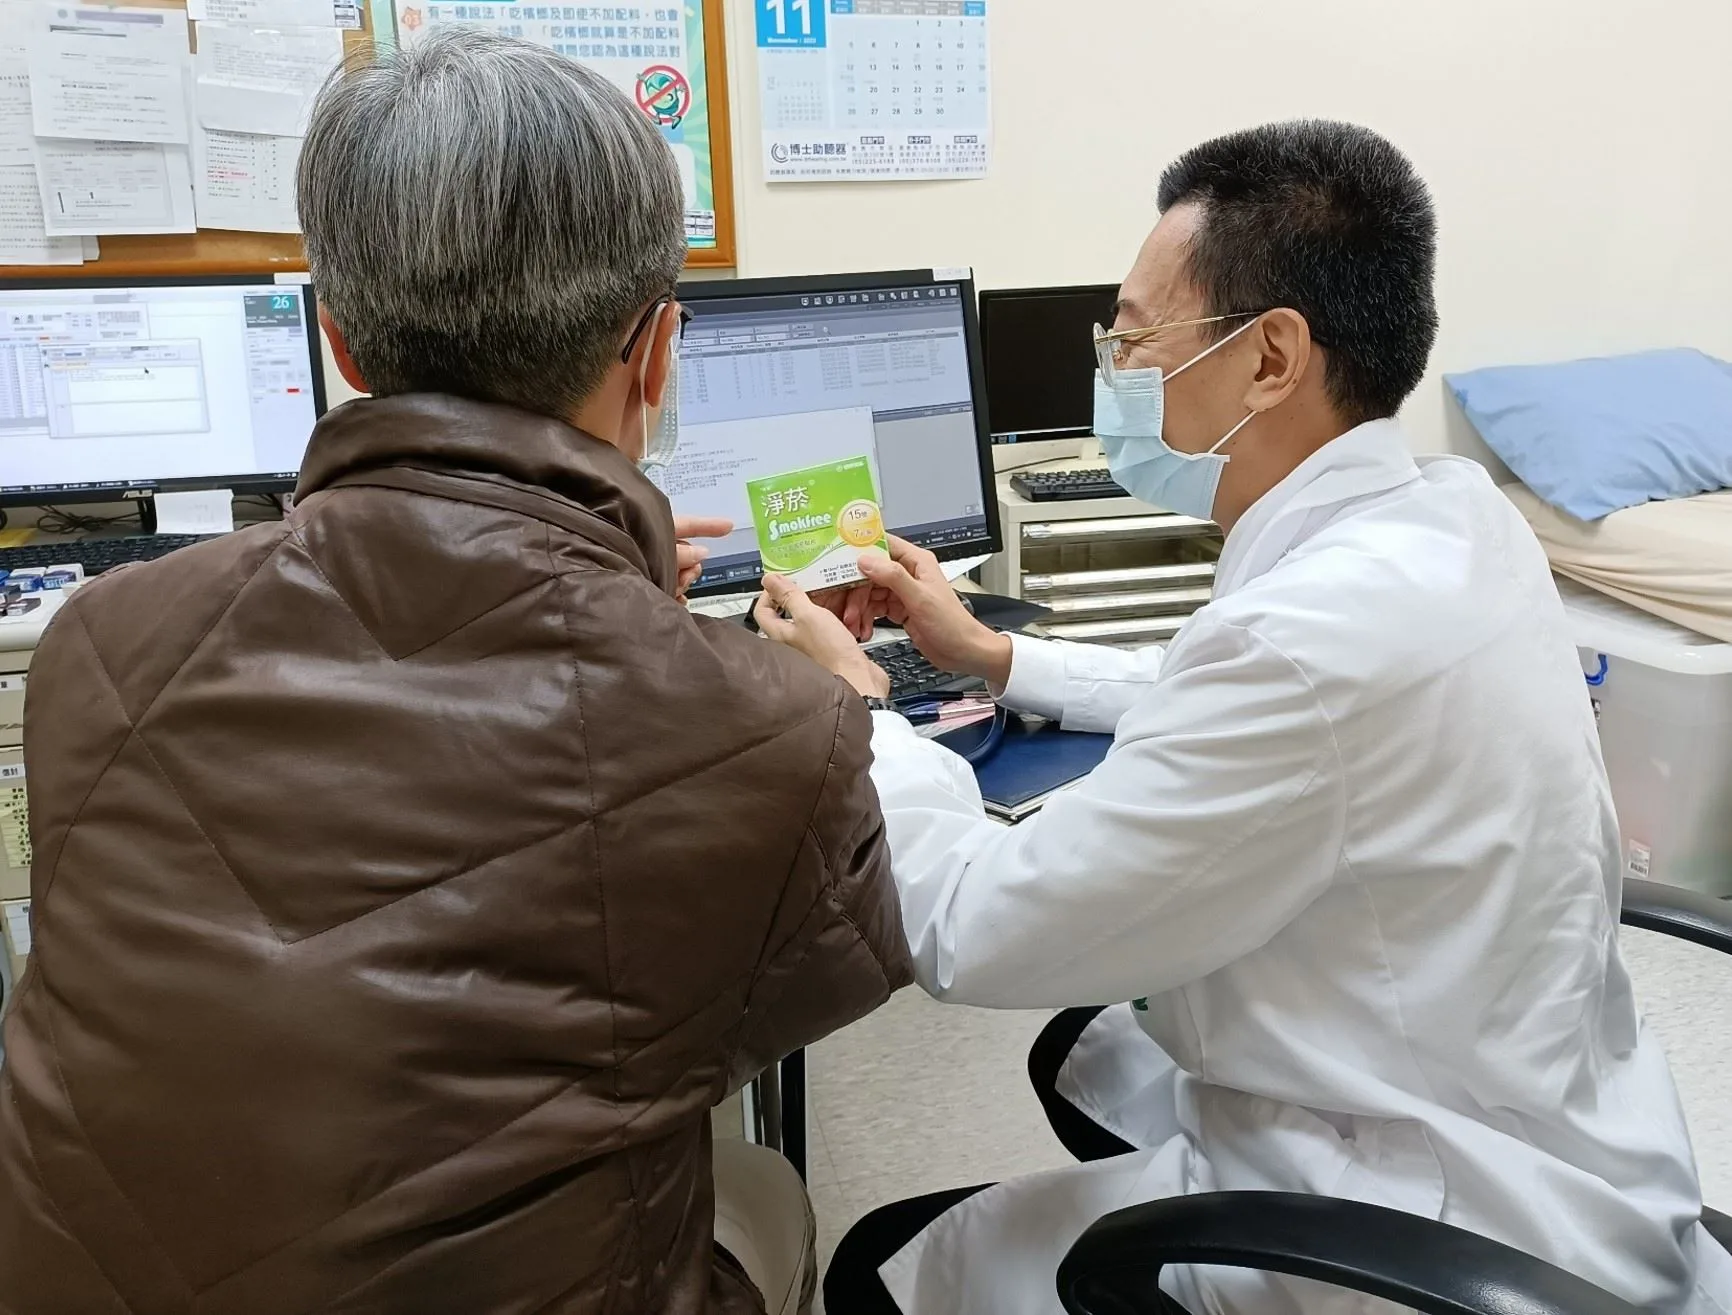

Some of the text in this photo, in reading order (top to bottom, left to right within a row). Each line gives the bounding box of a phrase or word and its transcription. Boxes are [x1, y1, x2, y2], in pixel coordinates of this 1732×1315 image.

[766, 0, 811, 34] 11
[790, 144, 846, 155] 博士助聽器
[272, 296, 290, 309] 26
[761, 486, 809, 518] 淨菸
[768, 513, 832, 541] Smokfree
